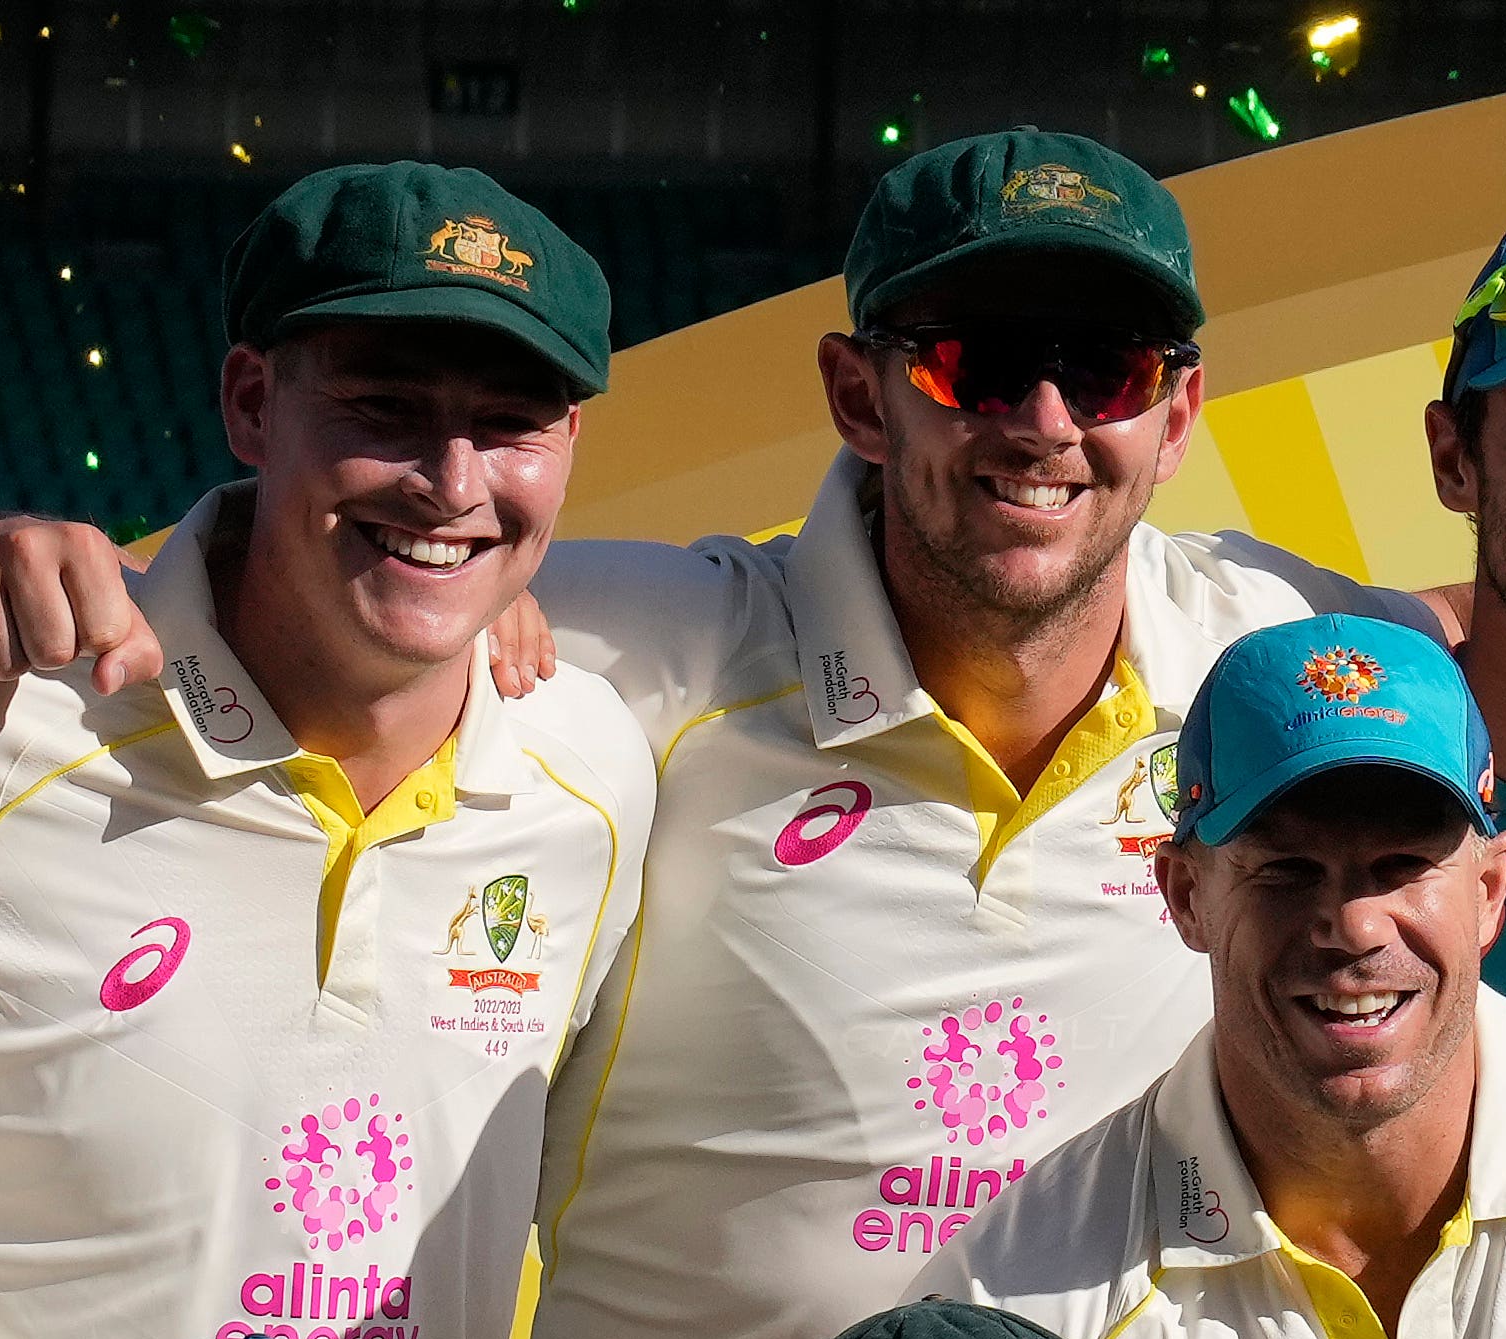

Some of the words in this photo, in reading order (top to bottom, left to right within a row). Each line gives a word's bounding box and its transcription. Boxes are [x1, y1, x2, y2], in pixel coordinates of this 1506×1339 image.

[171, 660, 208, 733] Foundation
[185, 655, 216, 715] McGrath
[819, 655, 837, 716] Foundation
[834, 651, 852, 700] McGrath
[1131, 881, 1160, 895] Indie
[472, 971, 526, 990] AUSTRALIA
[430, 1015, 457, 1031] West
[460, 1017, 489, 1032] Indies
[491, 1019, 500, 1032] &
[501, 1019, 525, 1033] South
[474, 999, 523, 1016] 2022/2023
[485, 1040, 509, 1057] 449
[1178, 1160, 1192, 1229] Foundation
[1189, 1156, 1205, 1215] McGrath
[240, 1262, 413, 1320] alinta
